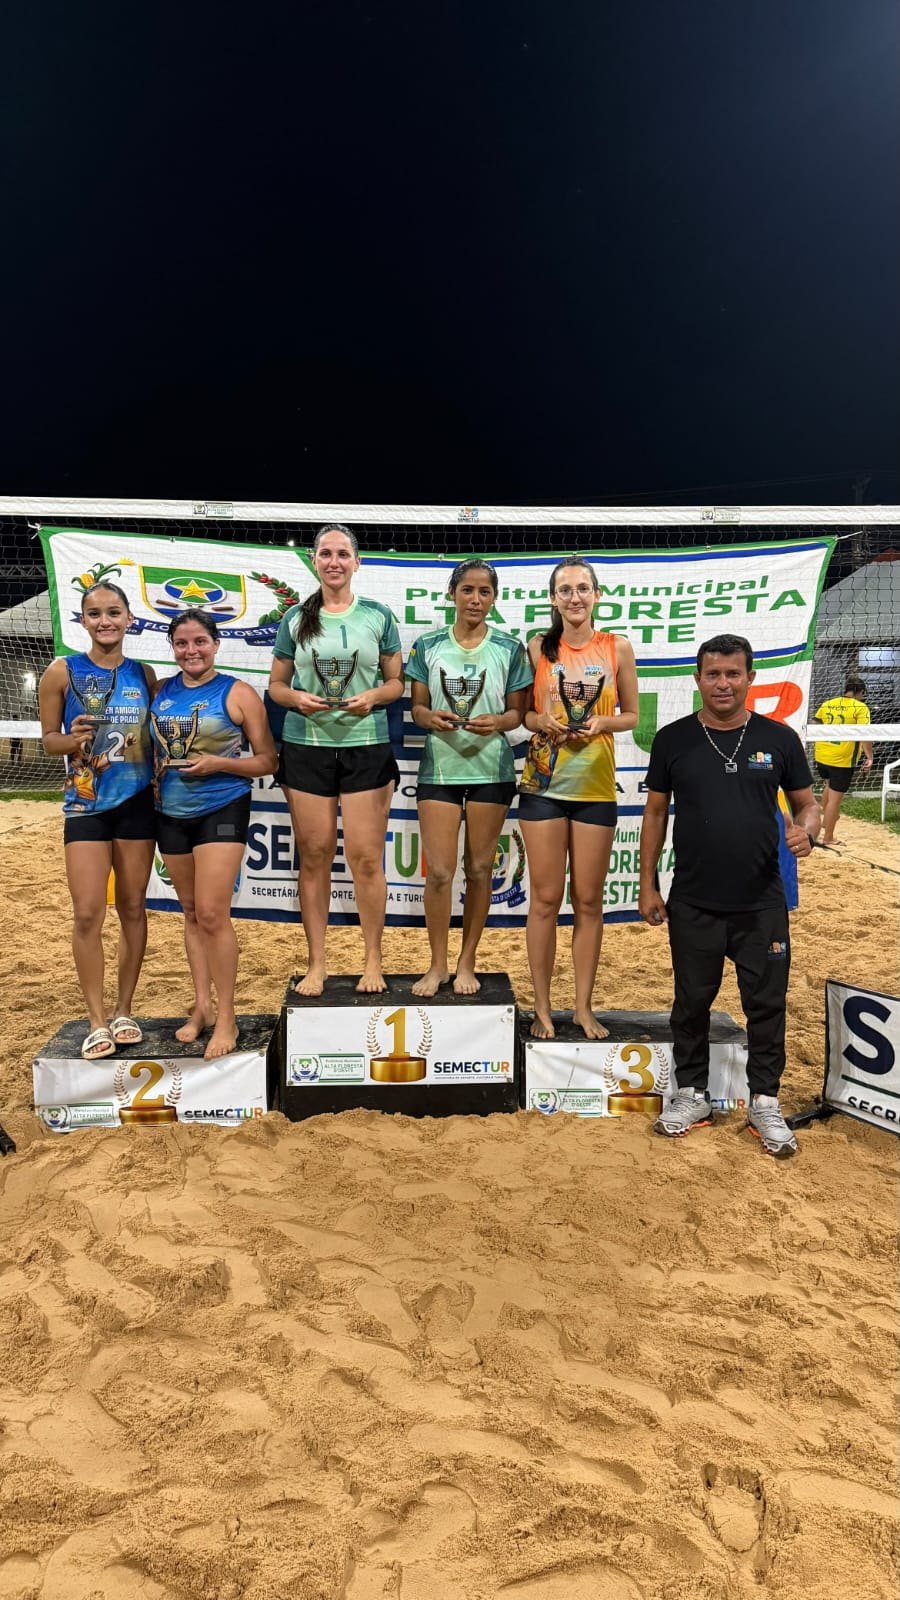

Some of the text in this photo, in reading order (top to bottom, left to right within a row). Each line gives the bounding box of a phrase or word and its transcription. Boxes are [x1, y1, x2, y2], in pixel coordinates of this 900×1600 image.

[600, 575, 769, 597] Municipal
[394, 589, 807, 625] LTA FORESTA
[339, 625, 348, 648] 1
[120, 715, 139, 724] PRAIA
[107, 731, 125, 761] 2
[331, 890, 356, 901] ORTE,
[396, 894, 402, 902] E
[403, 894, 424, 903] TURI
[383, 1008, 409, 1058] 1
[433, 1061, 510, 1073] SEMECTUR
[619, 1044, 655, 1094] 3
[129, 1060, 165, 1108] 2
[184, 1107, 264, 1119] SEMECTUR
[710, 1098, 746, 1110] CTUR
